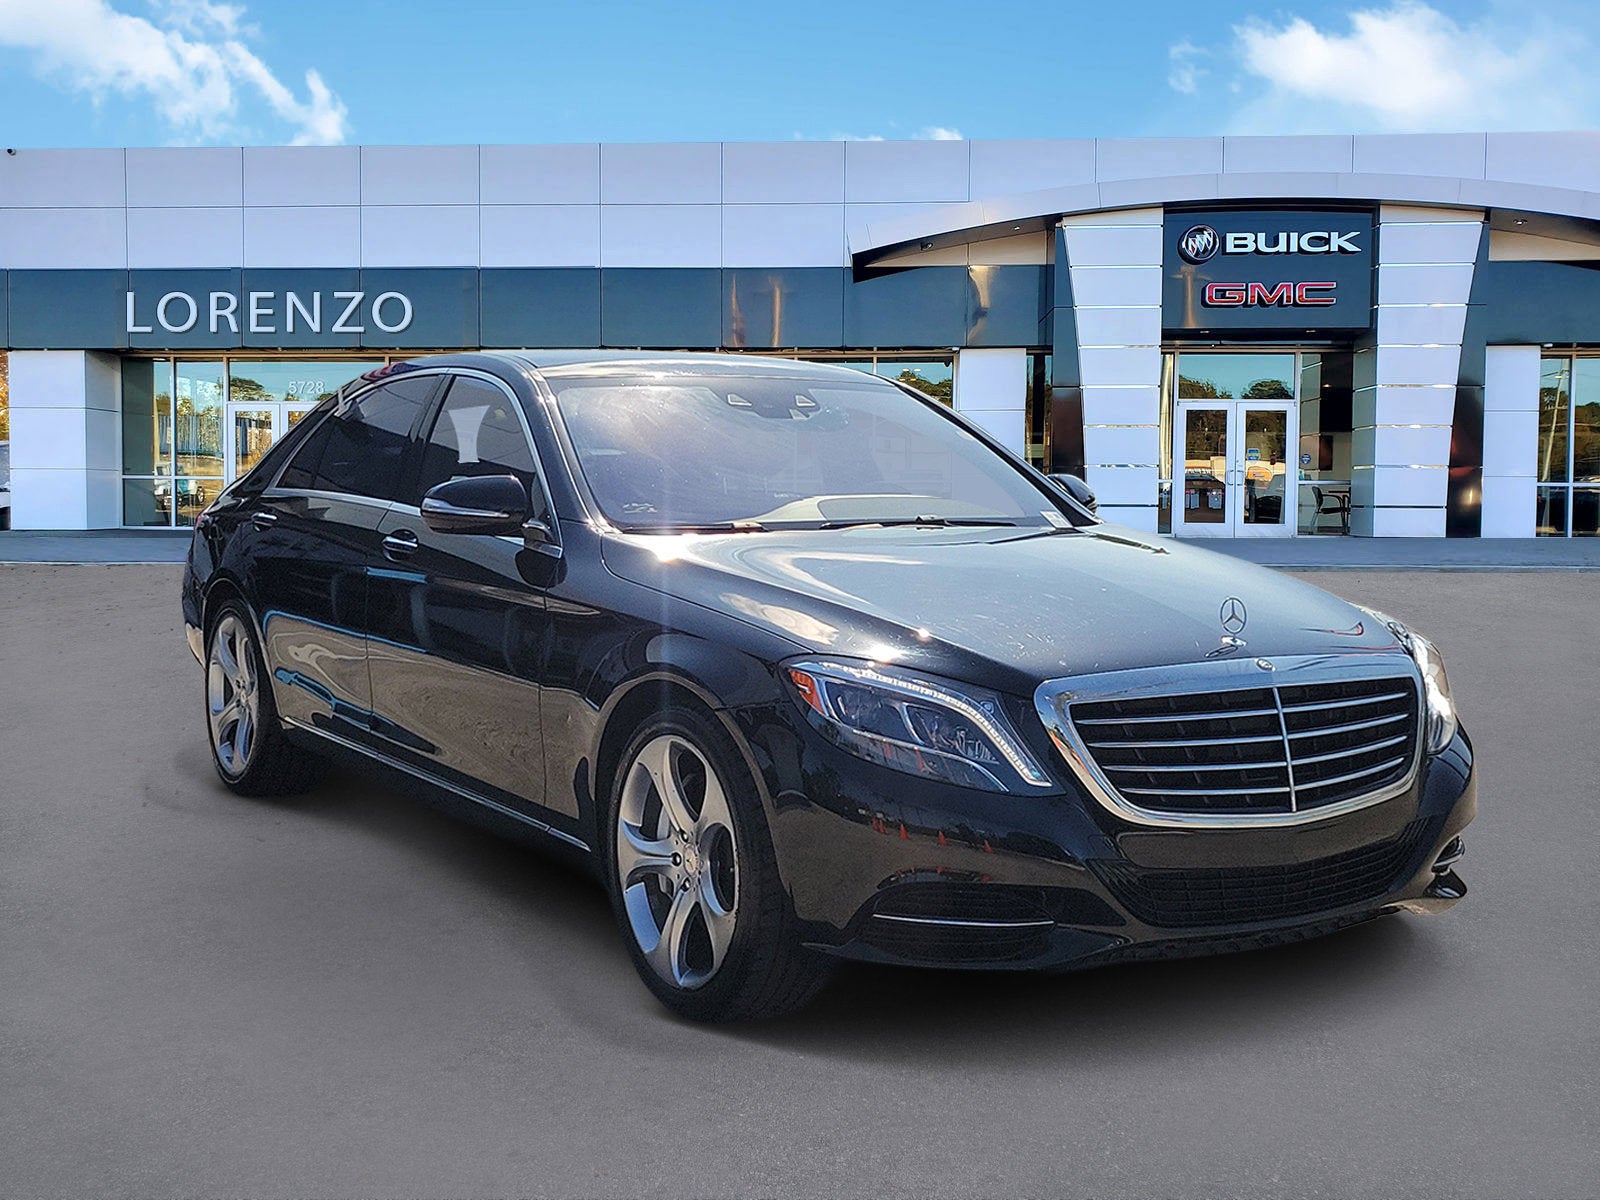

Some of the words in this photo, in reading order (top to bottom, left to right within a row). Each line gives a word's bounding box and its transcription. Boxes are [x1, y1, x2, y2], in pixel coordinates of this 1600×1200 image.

[1225, 231, 1362, 253] BUICK
[1206, 282, 1337, 305] GMC
[126, 291, 413, 333] LORENZO
[288, 380, 325, 395] 5728
